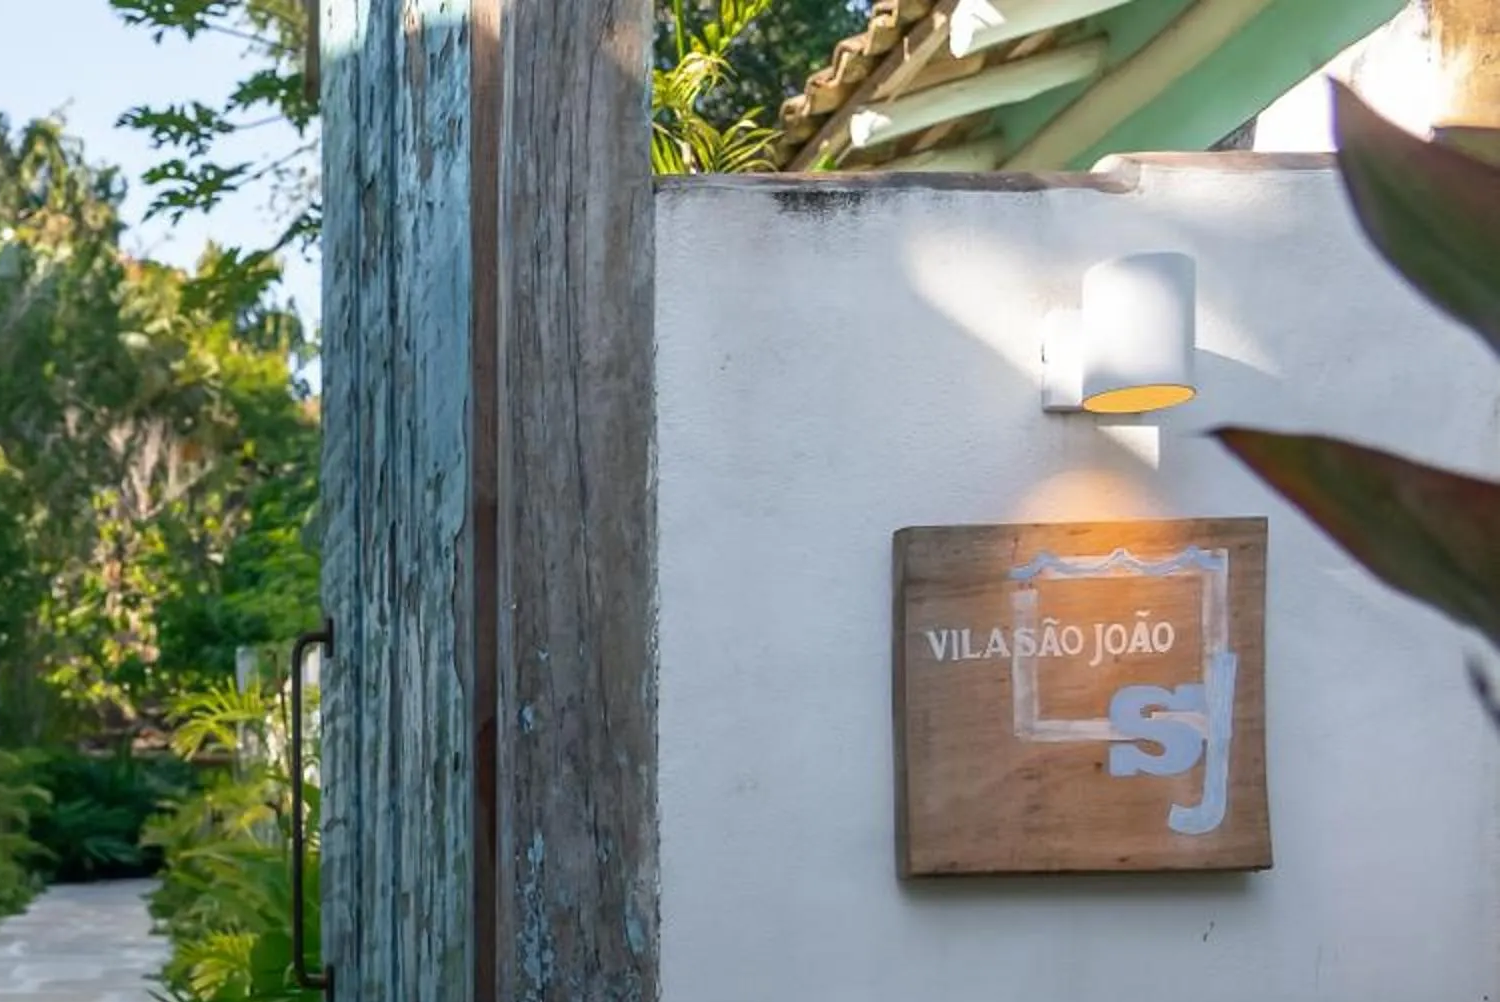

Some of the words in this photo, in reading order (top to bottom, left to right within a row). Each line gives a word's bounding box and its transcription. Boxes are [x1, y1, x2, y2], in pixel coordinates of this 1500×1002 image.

[925, 627, 1011, 661] VILA
[1013, 617, 1084, 658] SÃO
[1090, 611, 1175, 666] JOÃO
